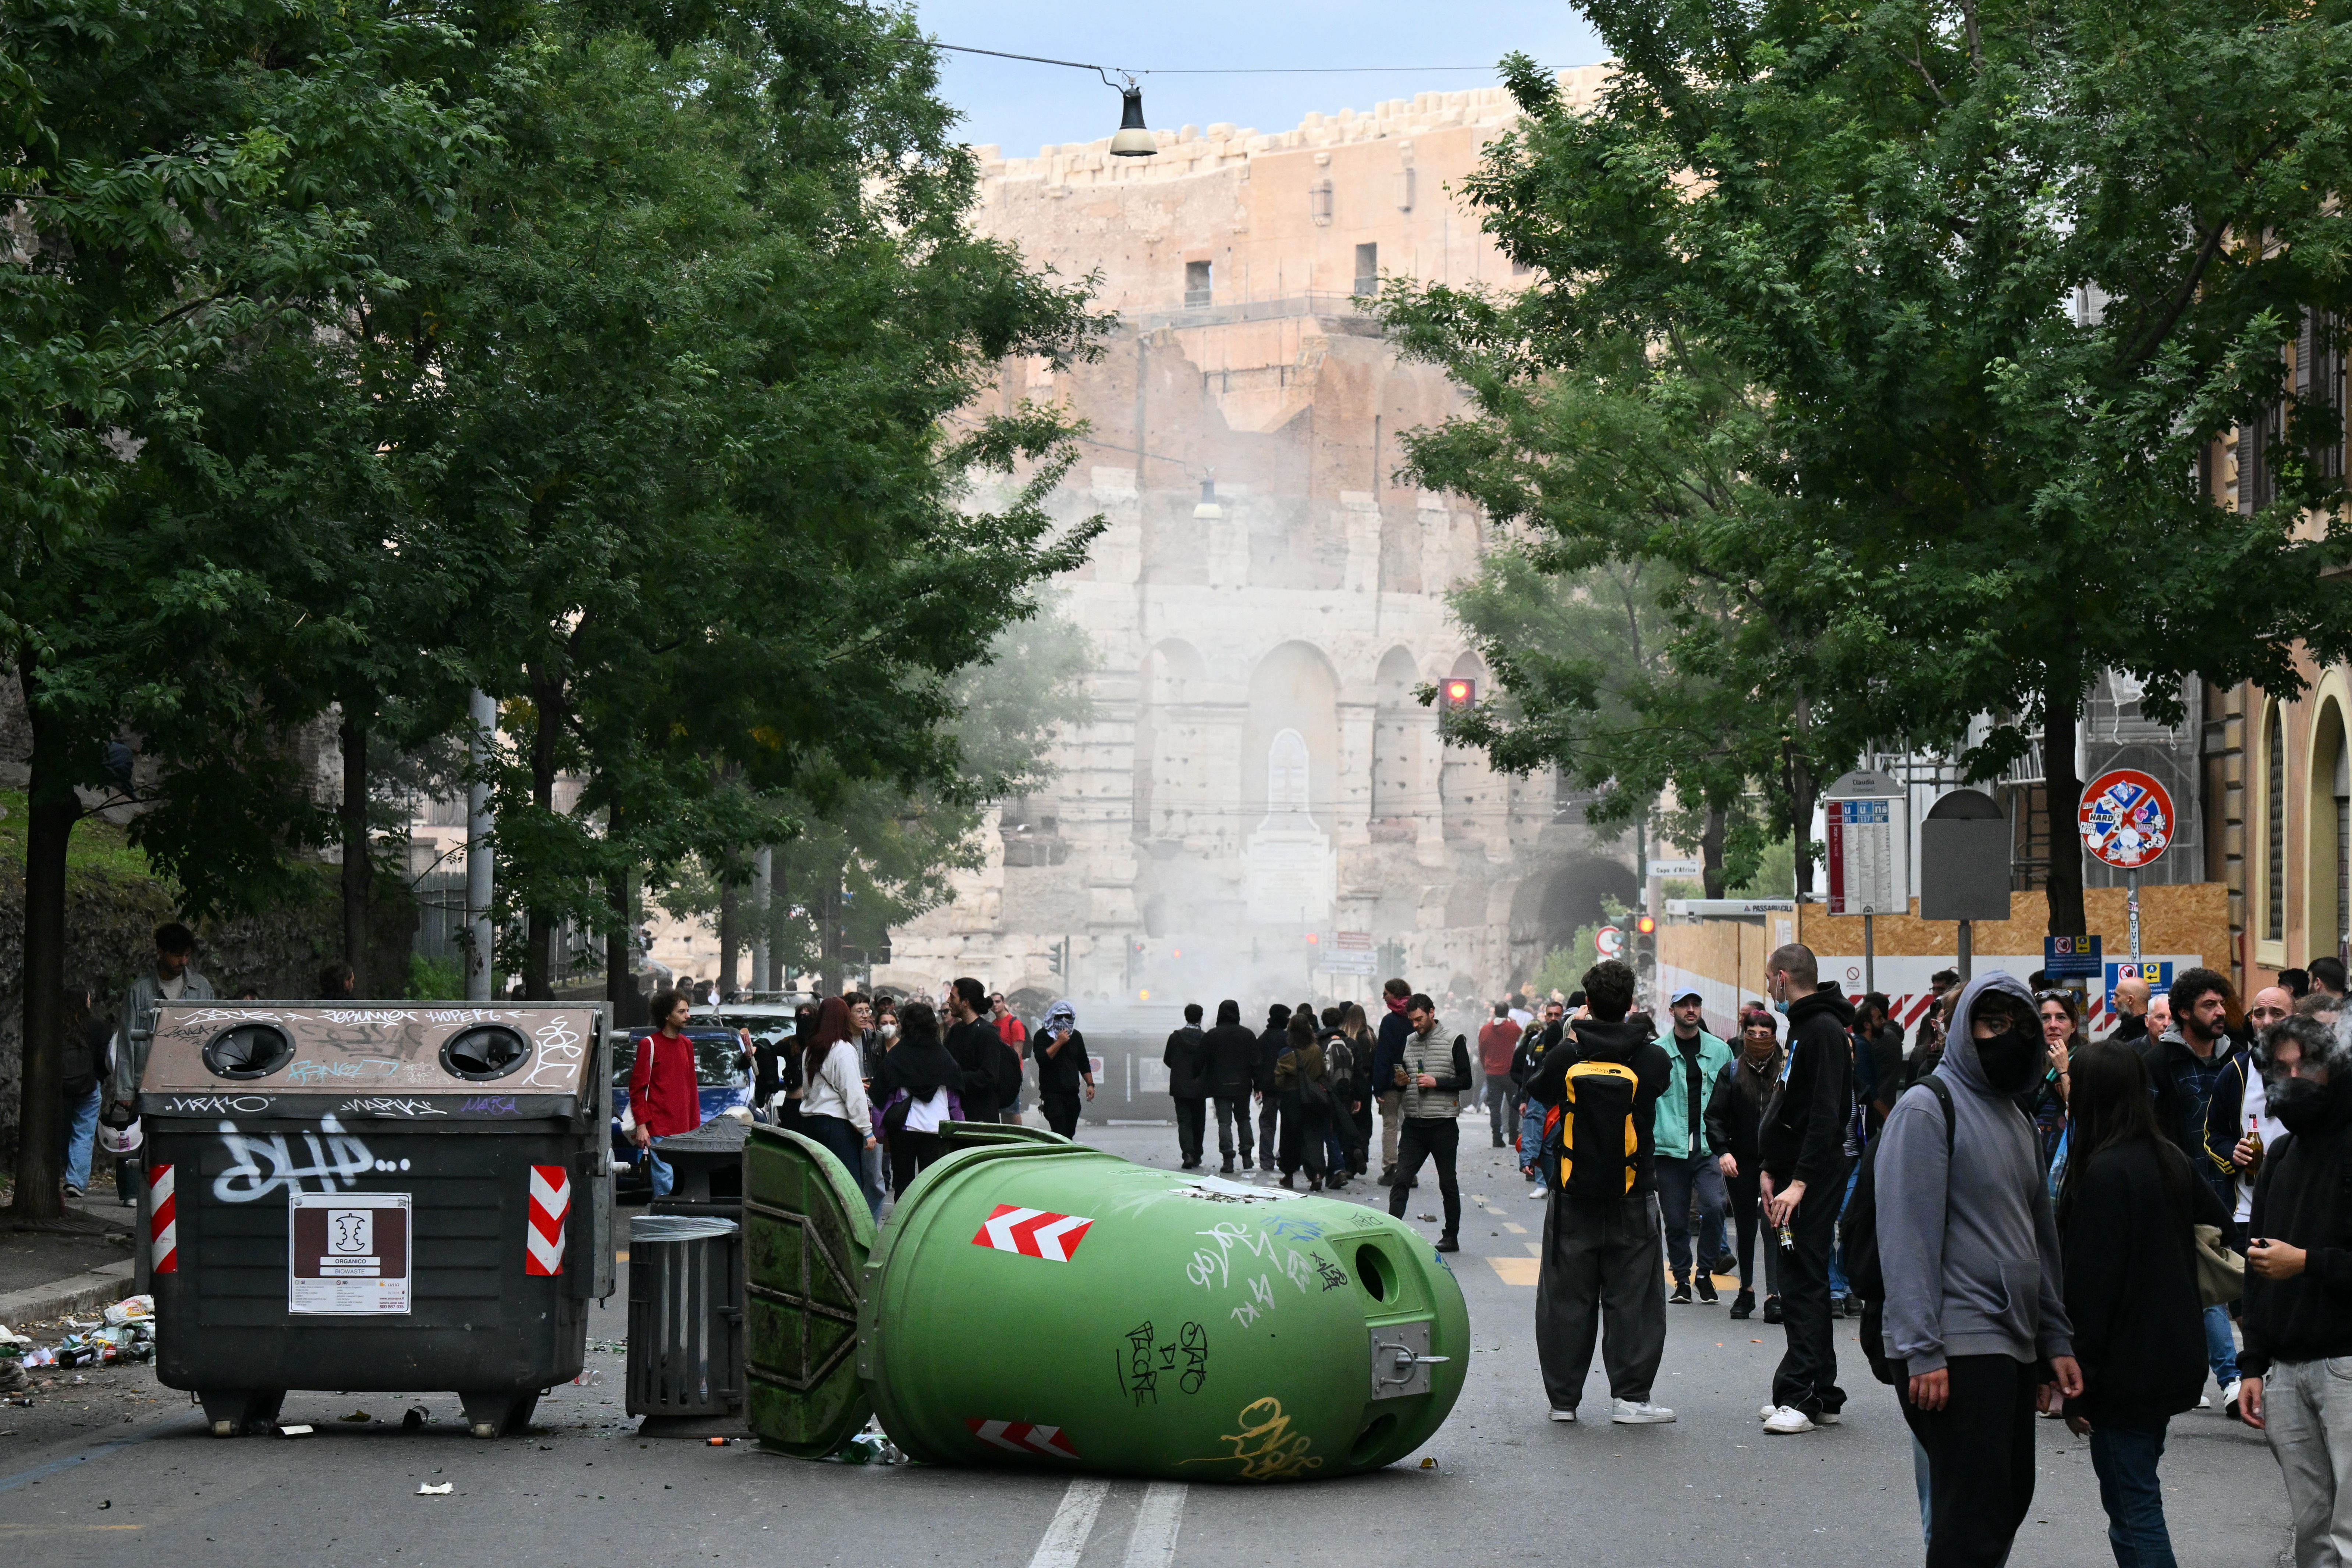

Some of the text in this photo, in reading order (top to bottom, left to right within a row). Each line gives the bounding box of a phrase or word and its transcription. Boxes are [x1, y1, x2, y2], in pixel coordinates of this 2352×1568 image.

[2080, 828, 2095, 836] IKON
[2081, 821, 2096, 829] PHISH
[1159, 1343, 1176, 1370] DI
[1179, 1321, 1208, 1394] STATO
